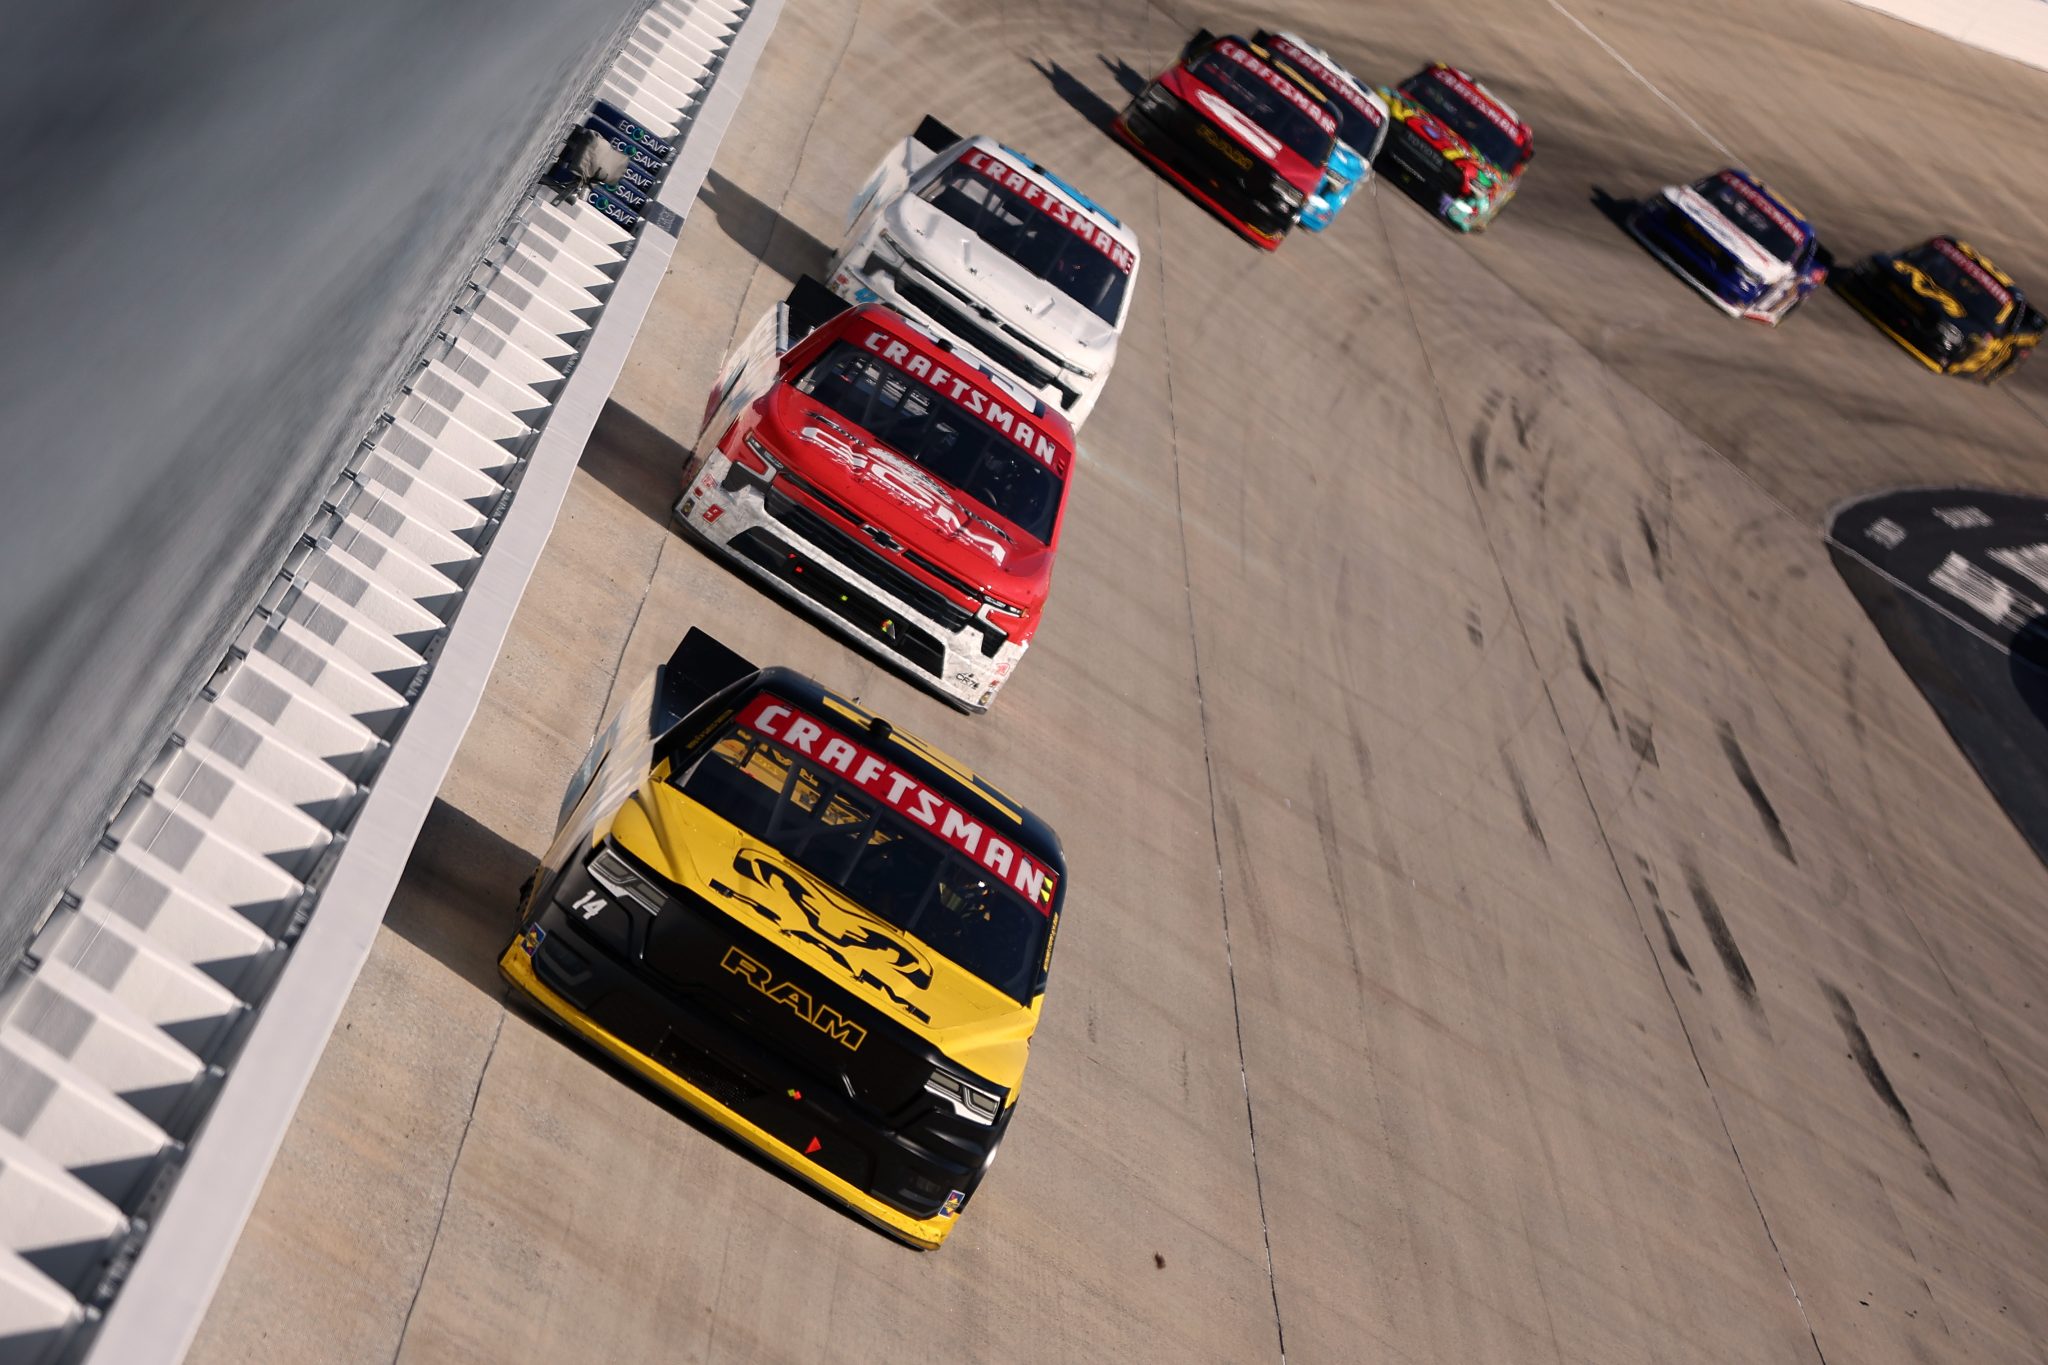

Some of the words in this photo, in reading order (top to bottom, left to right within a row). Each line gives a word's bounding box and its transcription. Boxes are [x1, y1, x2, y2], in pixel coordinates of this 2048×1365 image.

[1221, 42, 1336, 134] CRAFTSMAN
[968, 152, 1130, 269] CRAFTSMAN
[864, 331, 1057, 466] CRAFTSMAN
[754, 704, 1045, 904] CRAFTSMAN
[572, 889, 608, 920] 14
[720, 945, 868, 1052] RAM
